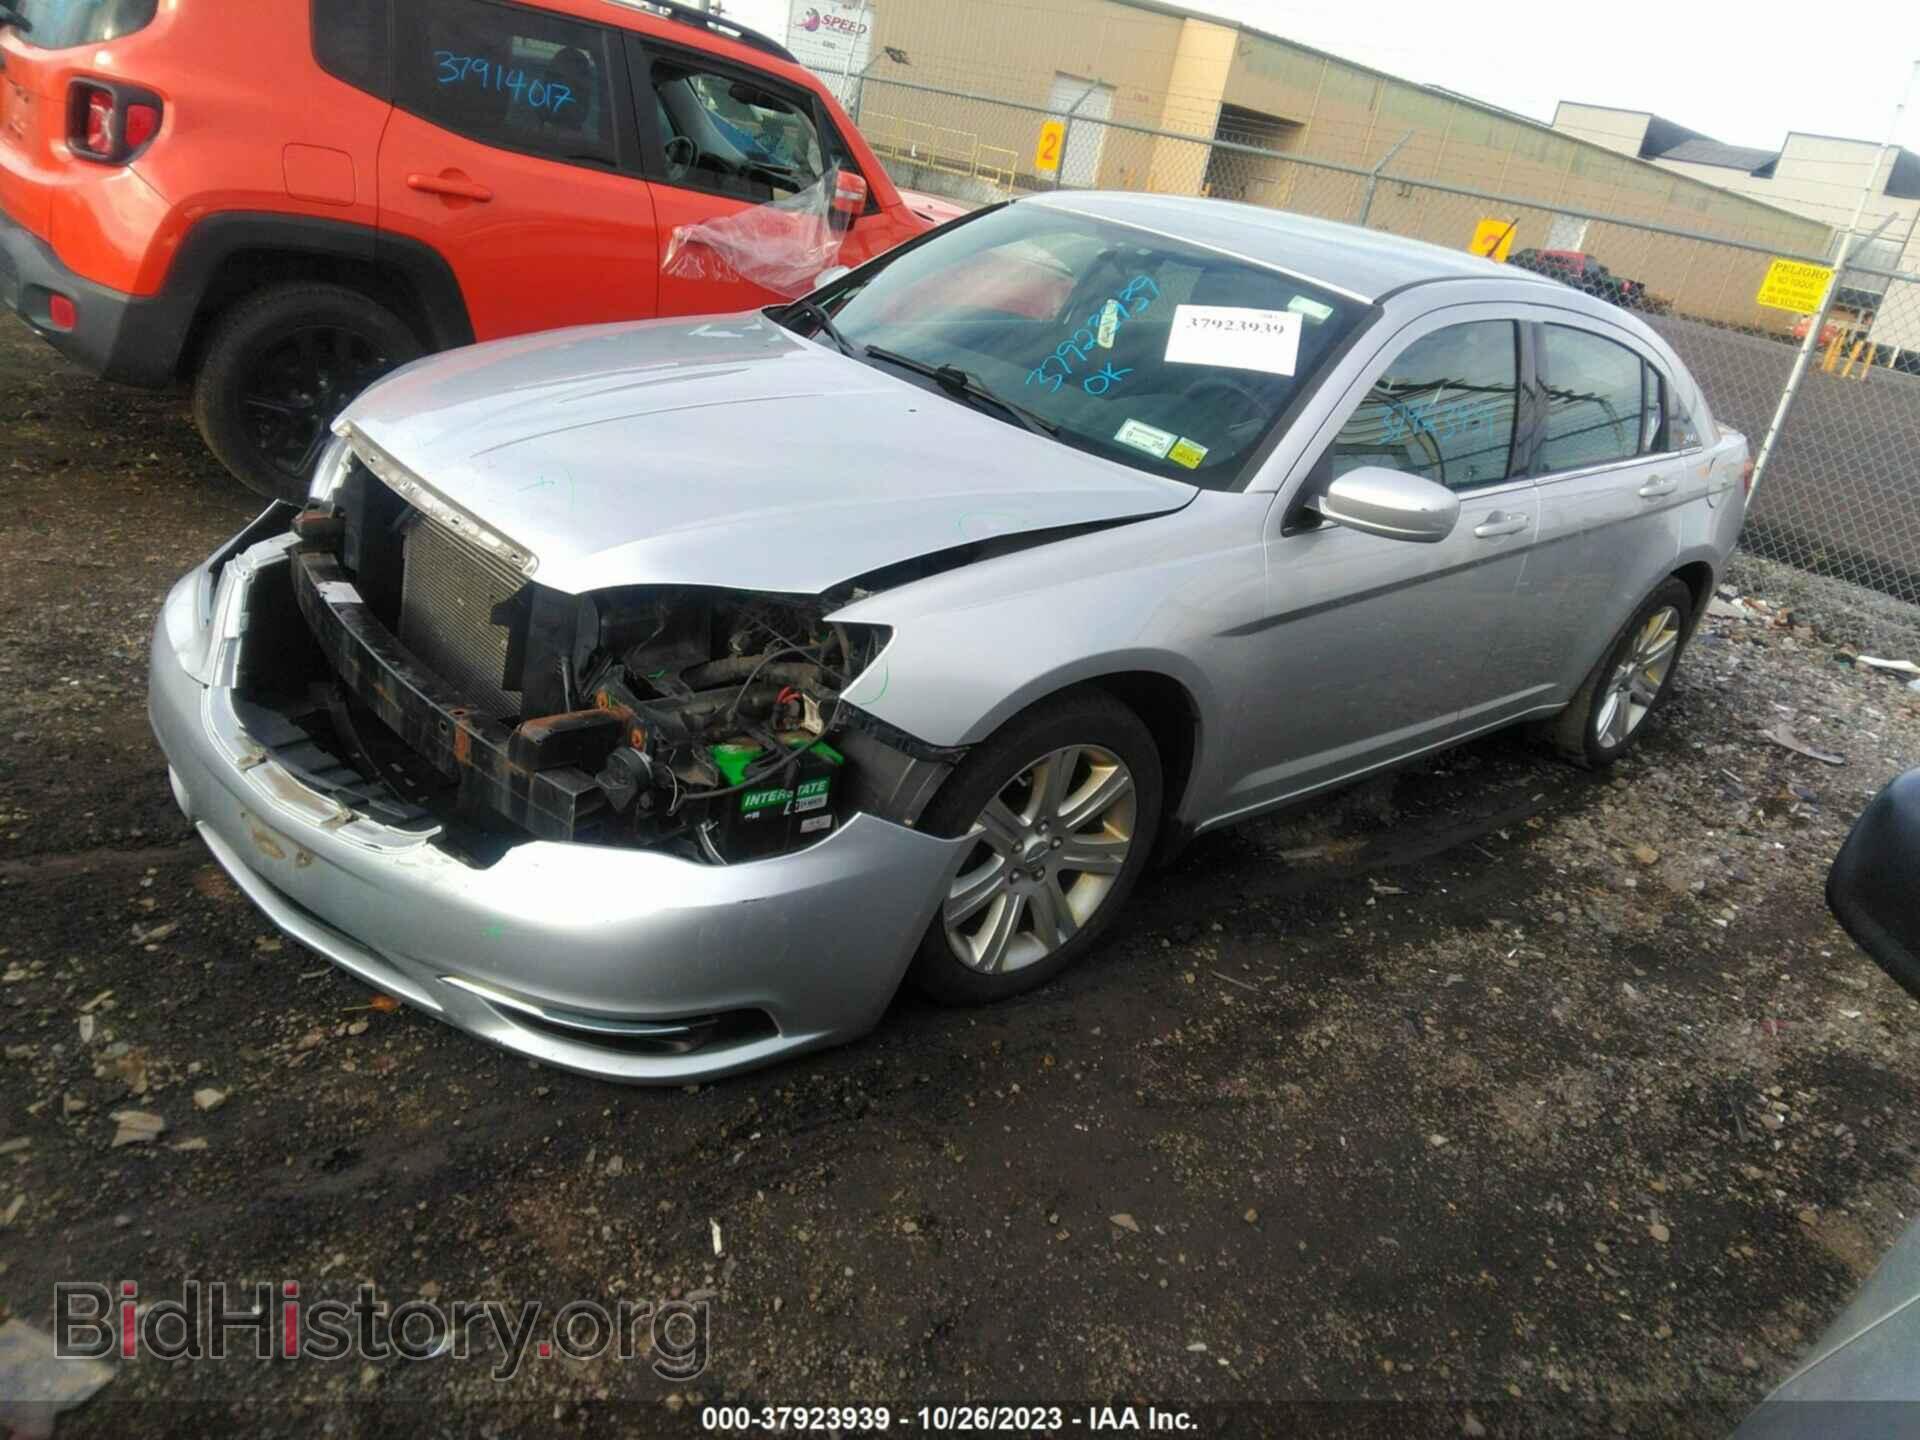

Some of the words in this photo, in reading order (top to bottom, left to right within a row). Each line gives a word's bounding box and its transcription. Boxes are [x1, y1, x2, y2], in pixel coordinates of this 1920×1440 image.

[821, 14, 868, 34] SPEED
[433, 50, 576, 113] 37914017
[1043, 132, 1057, 160] 2
[1774, 262, 1830, 281] PELIGRO
[1186, 316, 1285, 335] 37923939
[1084, 362, 1135, 394] OK
